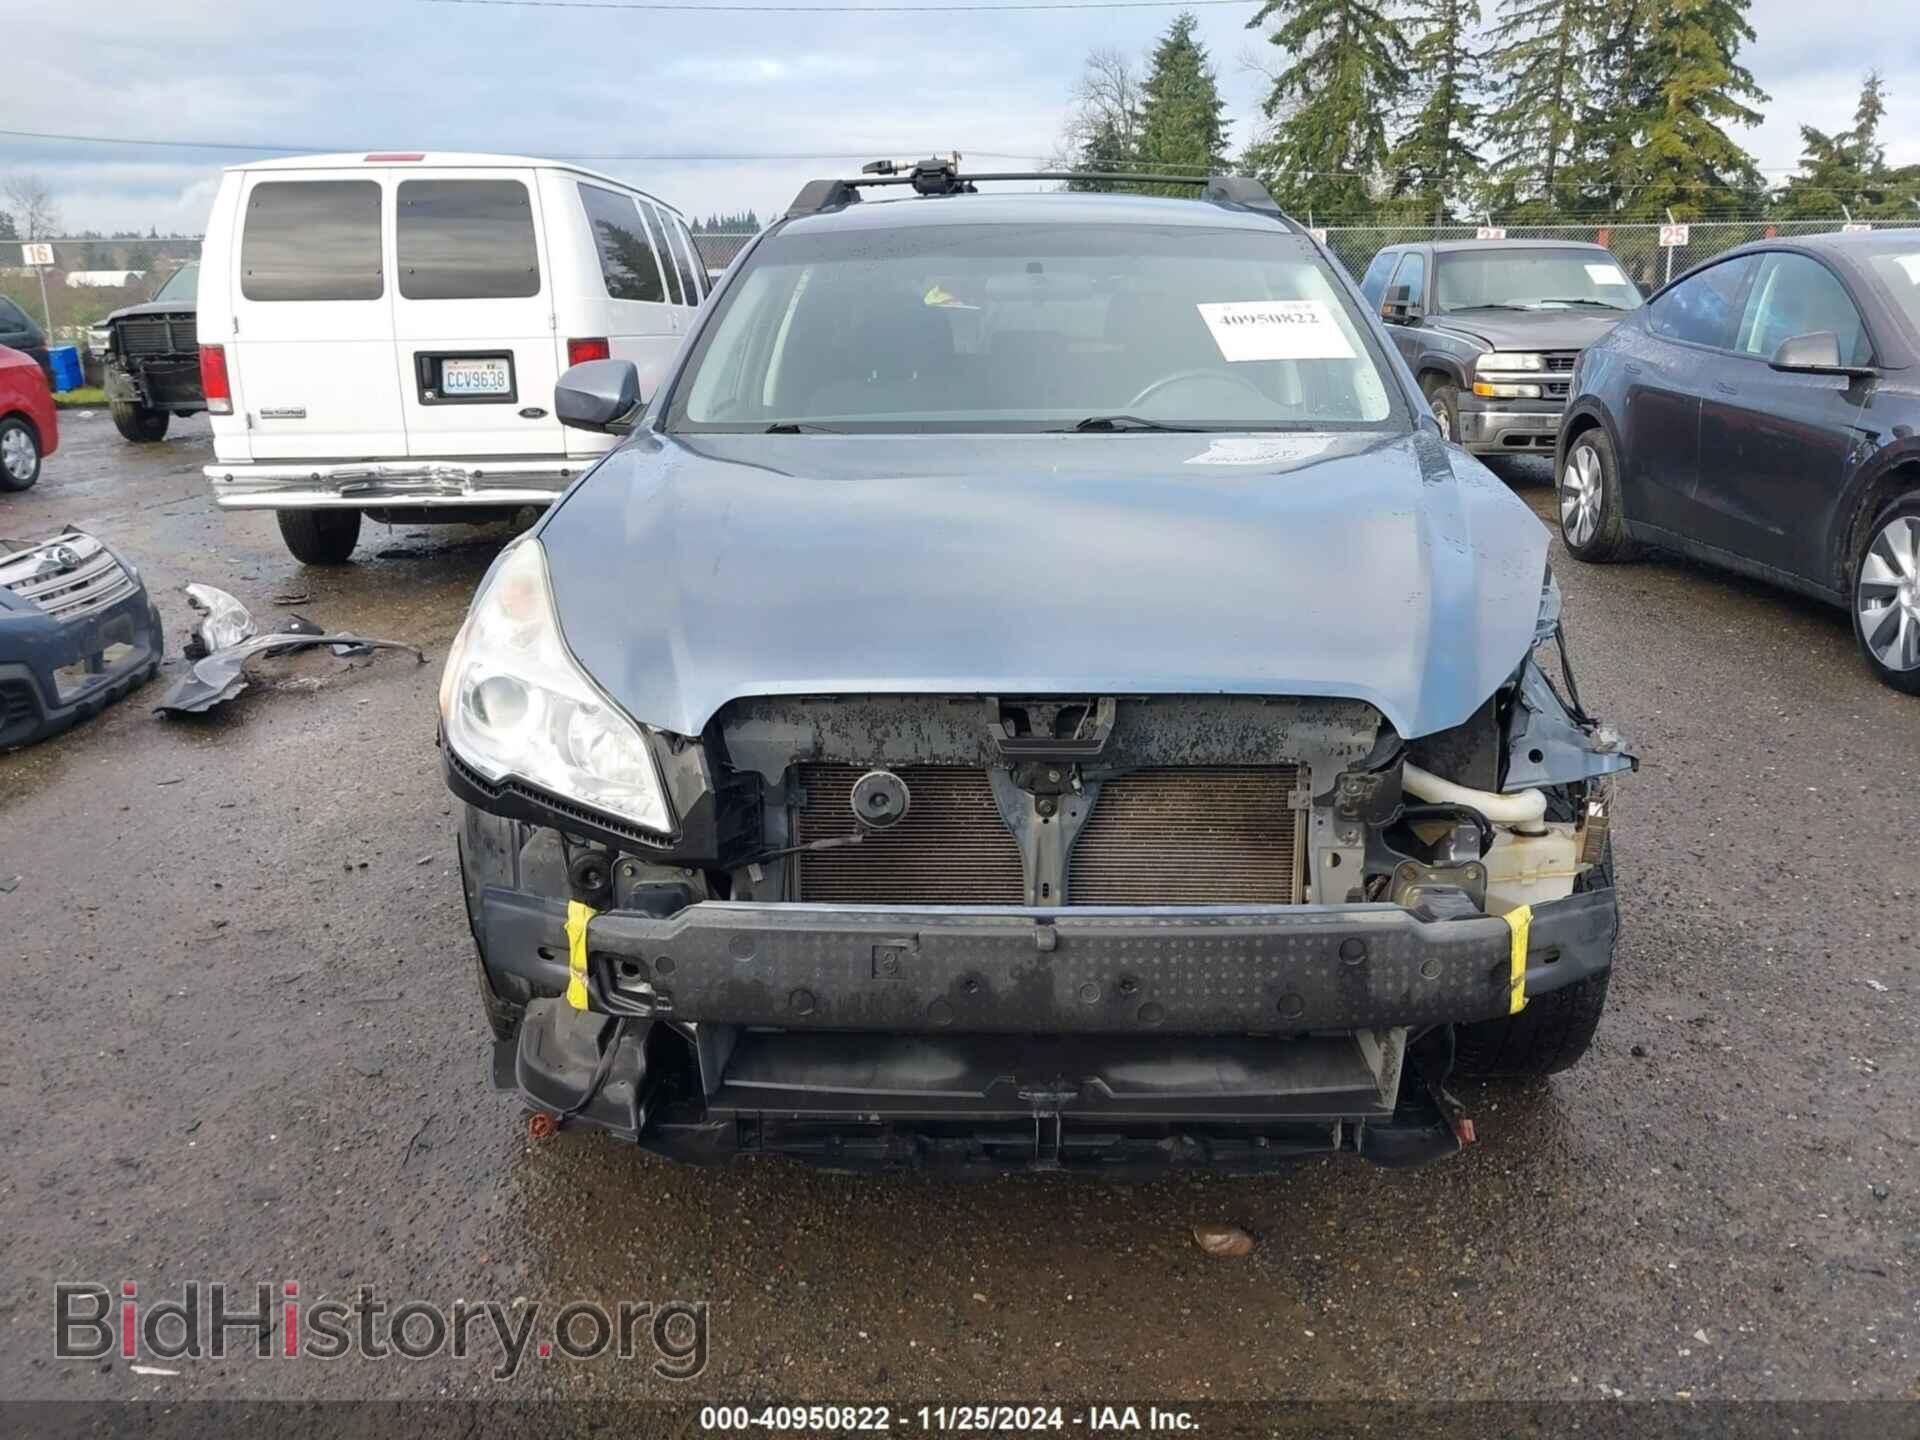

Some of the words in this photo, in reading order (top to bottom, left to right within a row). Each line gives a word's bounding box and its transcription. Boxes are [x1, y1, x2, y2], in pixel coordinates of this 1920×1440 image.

[1663, 227, 1686, 244] 25
[29, 245, 49, 262] 16
[1219, 312, 1320, 326] 40950822
[447, 371, 505, 388] CCV9638
